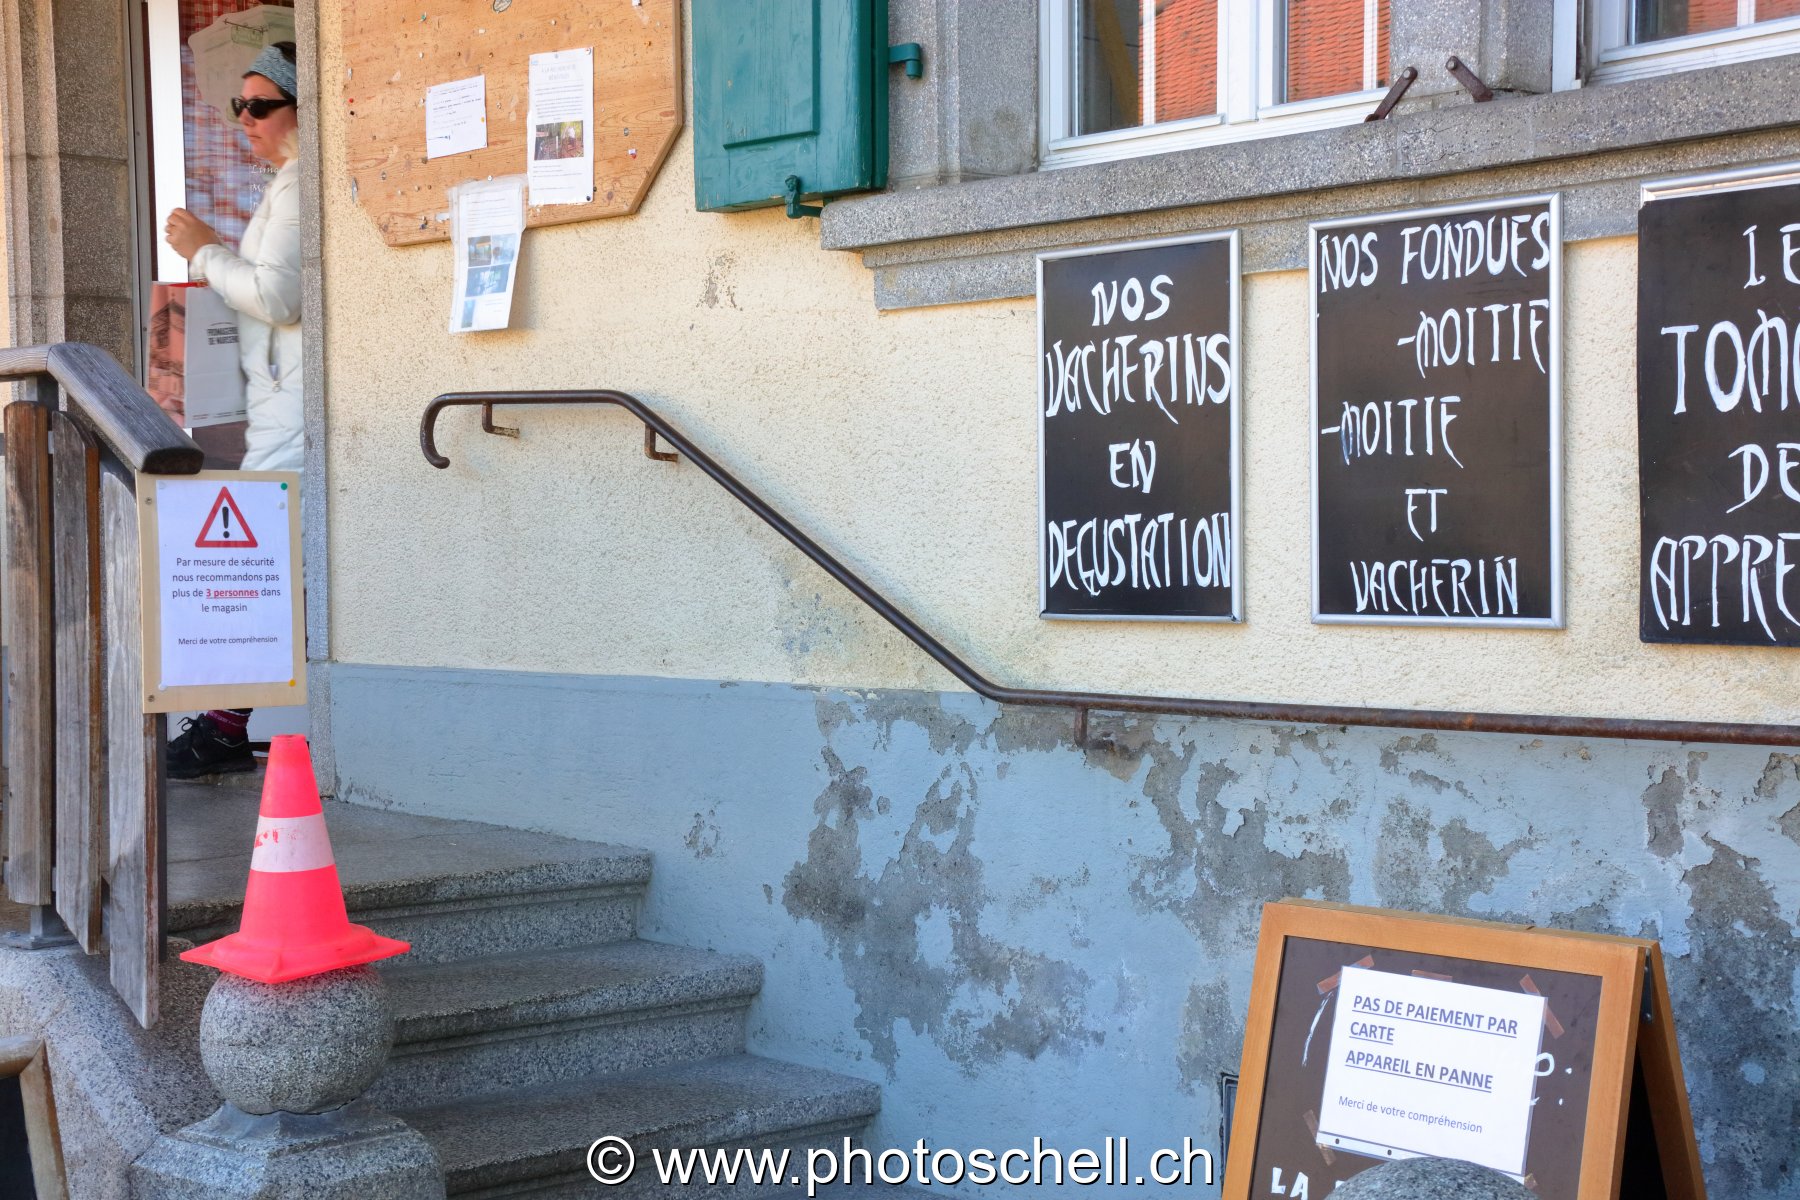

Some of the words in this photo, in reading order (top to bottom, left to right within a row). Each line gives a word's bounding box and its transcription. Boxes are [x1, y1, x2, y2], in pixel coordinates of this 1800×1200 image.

[1321, 231, 1379, 294] NOS
[1401, 210, 1550, 285] FONDUES
[1090, 274, 1174, 327] NOS
[1045, 333, 1231, 424] VACHERINS
[1660, 308, 1800, 415] TOM
[1108, 438, 1157, 494] EN
[1725, 442, 1800, 514] DE
[1404, 488, 1448, 542] ET
[176, 557, 191, 567] Par
[193, 559, 226, 567] mesure
[228, 557, 239, 567] de
[241, 556, 275, 566] sécurité
[1047, 512, 1230, 597] DEGUSTATION
[172, 574, 194, 582] nous
[196, 572, 263, 582] recommandons
[265, 574, 280, 583] pas
[172, 588, 191, 599] plus
[192, 588, 204, 598] de
[206, 588, 211, 599] 3
[213, 589, 259, 599] personnes
[261, 588, 281, 597] dans
[1349, 555, 1519, 618] VACHERIN
[201, 603, 210, 613] le
[212, 603, 248, 614] magasin
[199, 637, 208, 645] de
[228, 636, 278, 645] compréhension
[1349, 1021, 1396, 1043] CARTE
[1353, 994, 1381, 1013] PAS
[1384, 999, 1404, 1016] DE
[1406, 1002, 1485, 1030] PAIEMENT
[1487, 1015, 1518, 1035] PAR
[1345, 1049, 1412, 1075] APPAREIL
[1415, 1061, 1436, 1079] EN
[1439, 1066, 1494, 1090] PANNE
[1338, 1095, 1365, 1110] Merci
[1366, 1100, 1379, 1113] de
[1380, 1105, 1406, 1118] votre
[1407, 1111, 1484, 1134] compréhension
[1270, 1166, 1309, 1200] LA
